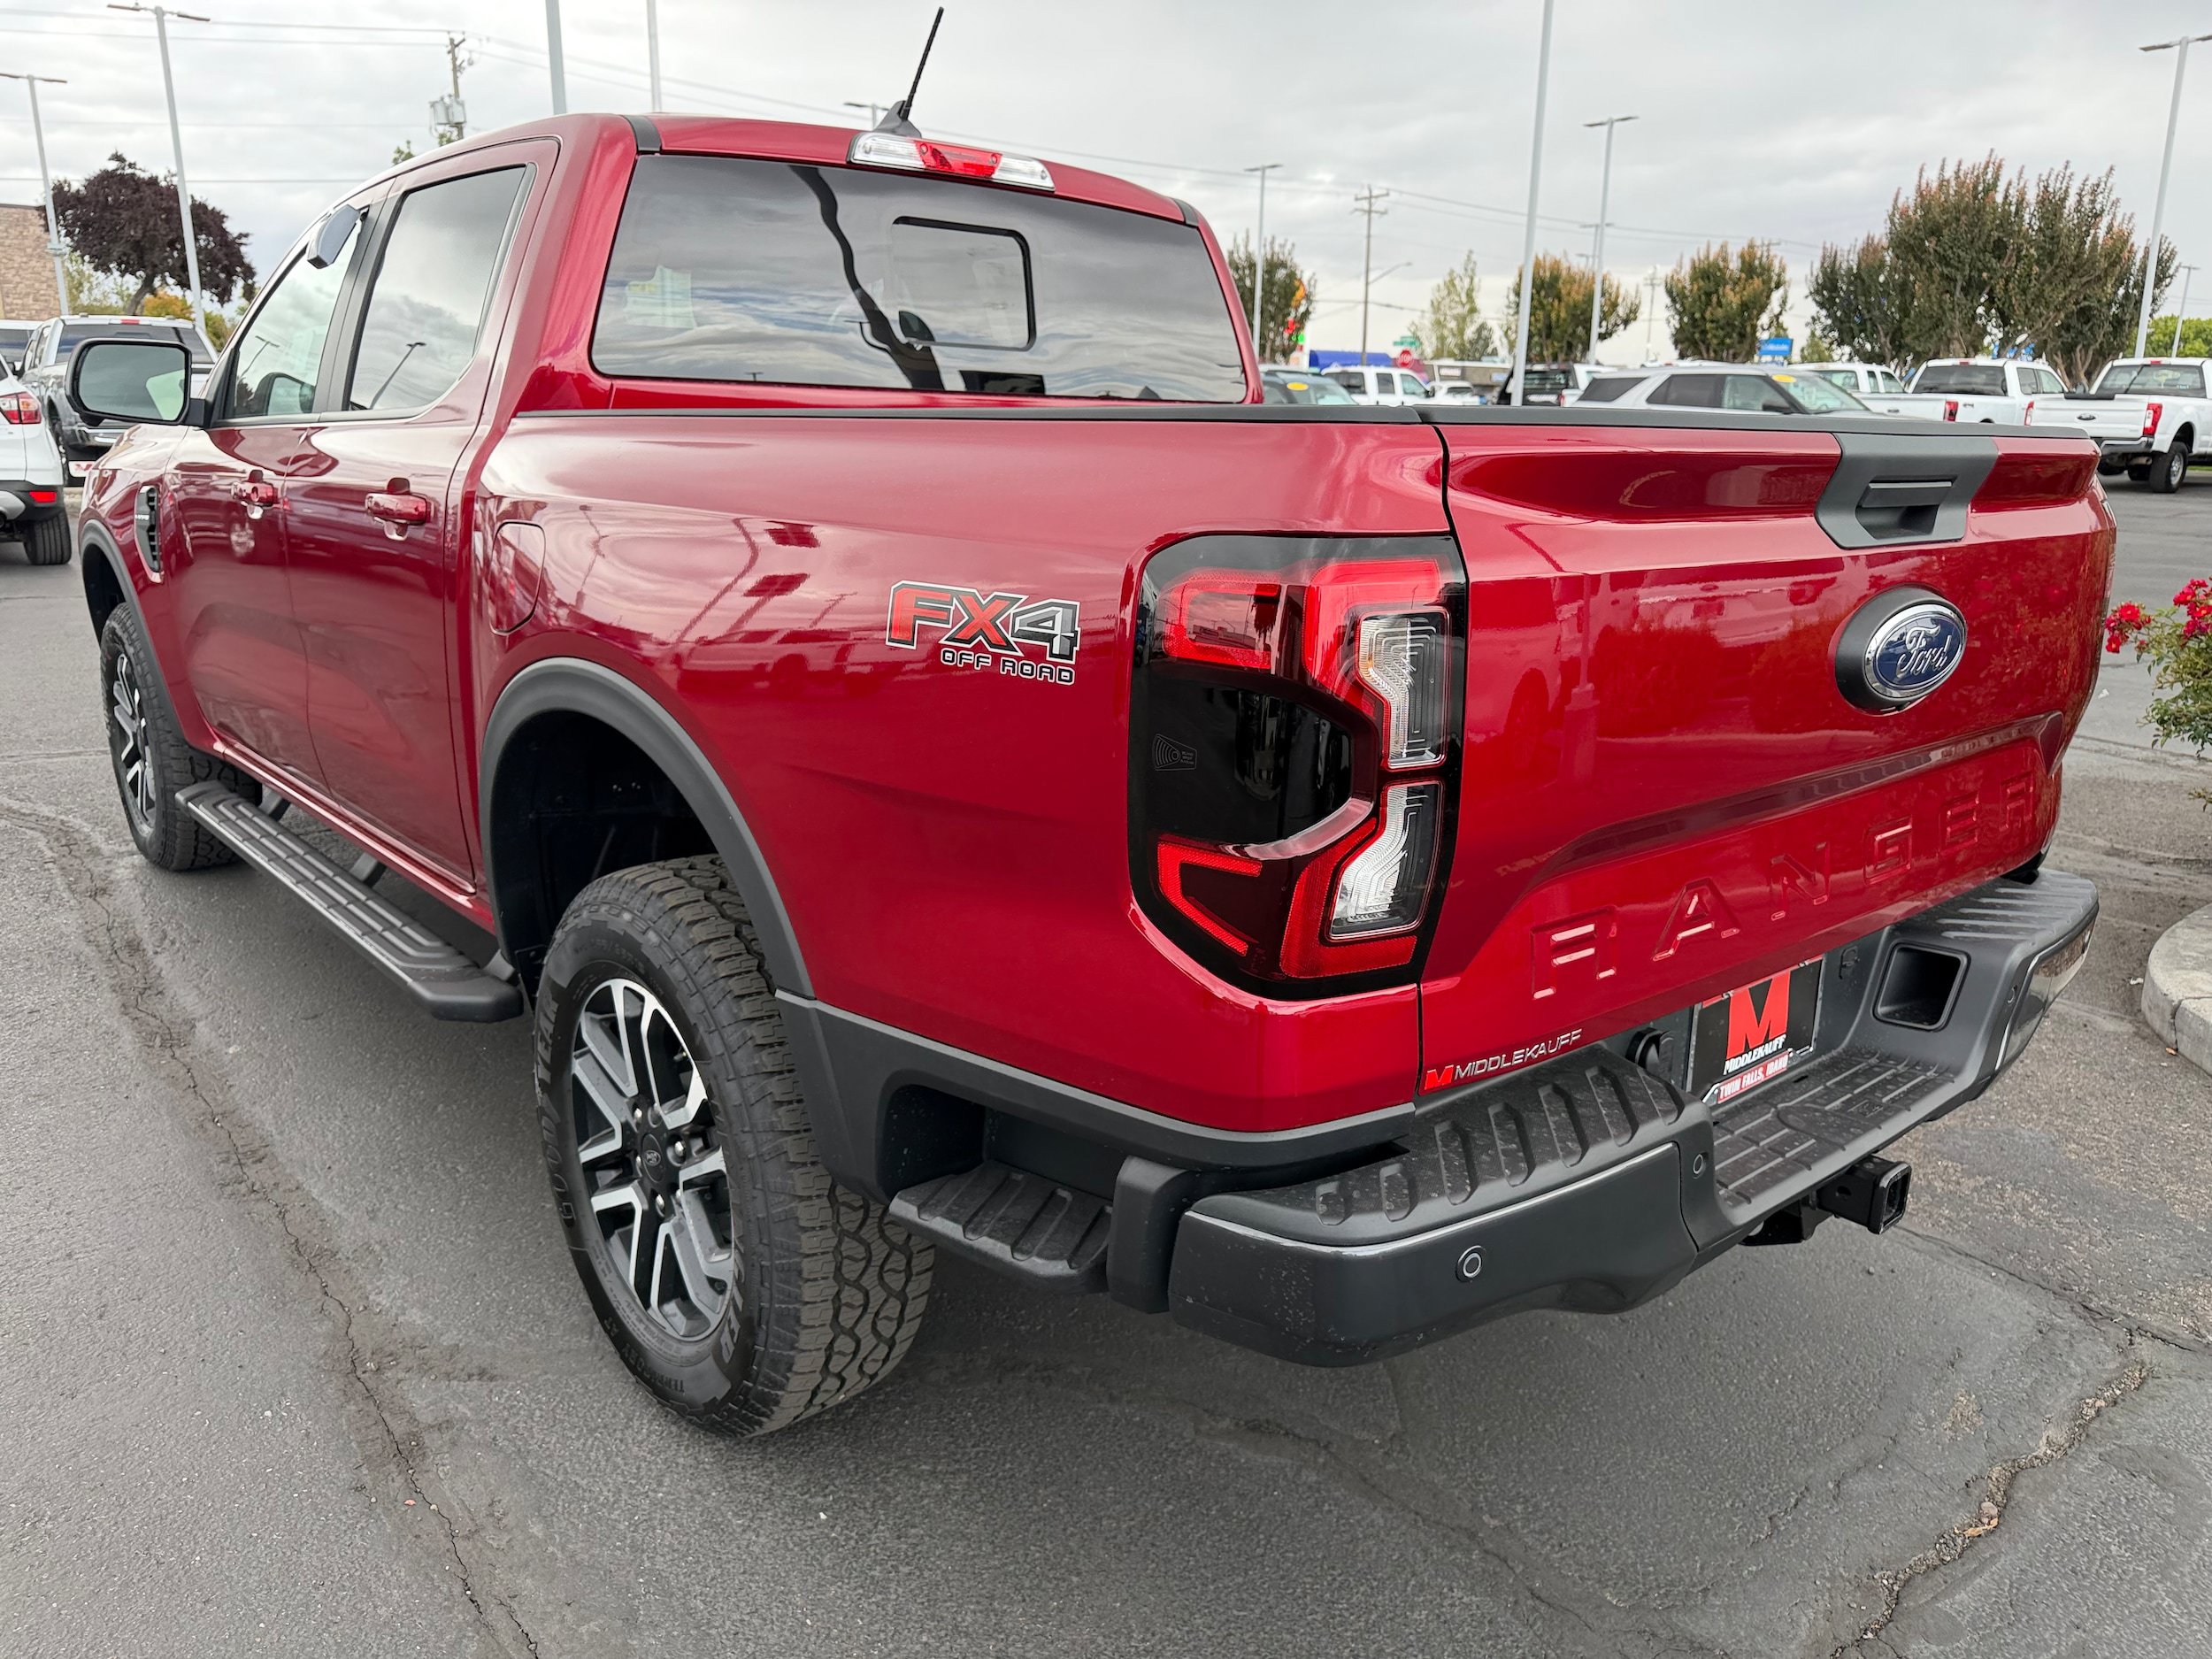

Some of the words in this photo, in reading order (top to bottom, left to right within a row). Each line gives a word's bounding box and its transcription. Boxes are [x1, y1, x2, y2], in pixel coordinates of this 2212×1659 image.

[886, 580, 1081, 664] FX4
[941, 648, 992, 670] OFF
[1000, 657, 1075, 686] ROAD
[1896, 625, 1952, 679] Ford
[1530, 772, 2034, 1000] RANGER
[1726, 967, 1791, 1060] M
[1454, 1028, 1582, 1080] MIDDLEKAUFF
[1719, 1079, 1741, 1100] TWIN
[1766, 1056, 1789, 1077] IDAHO
[1723, 1034, 1786, 1075] MIDDLEKAUFF
